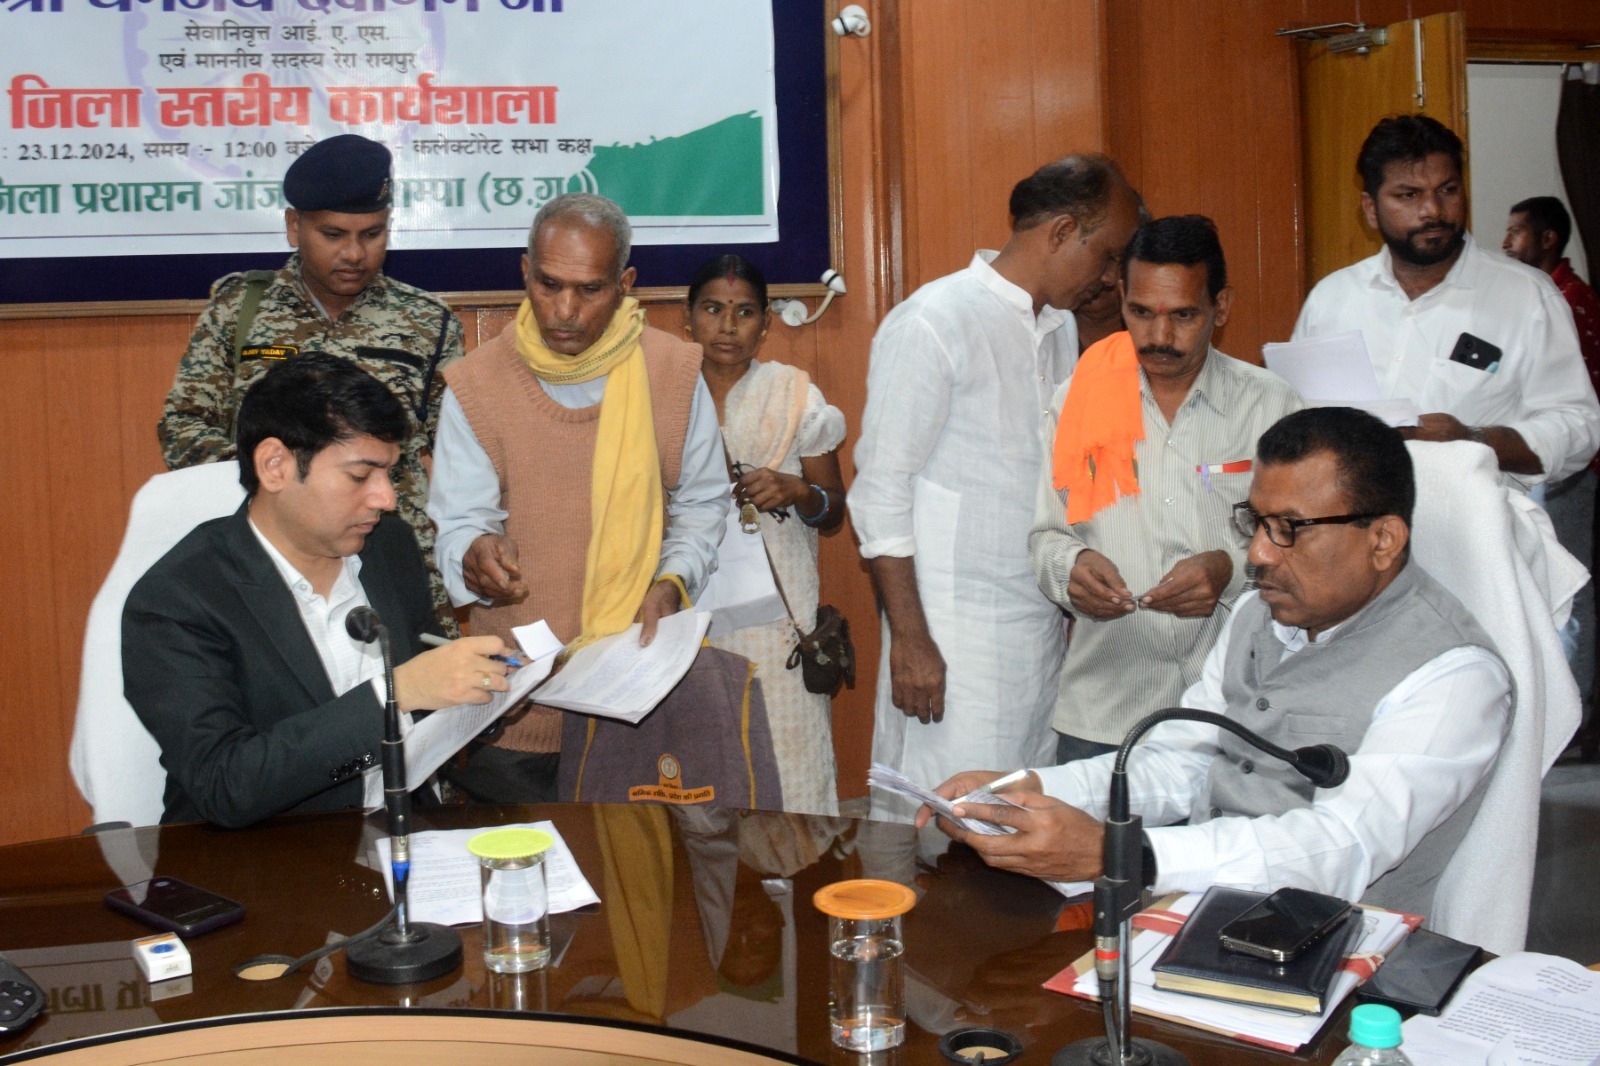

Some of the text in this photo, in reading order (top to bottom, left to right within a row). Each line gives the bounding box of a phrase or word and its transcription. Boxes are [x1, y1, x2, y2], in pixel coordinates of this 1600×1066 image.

[185, 19, 271, 47] सेवानिवृत्त
[159, 47, 416, 73] एवं माननीय सदस्य रेरा रायपुर
[7, 72, 559, 129] जिला स्तरीय कार्यशाला
[18, 142, 135, 163] 23.12.2024,
[144, 142, 189, 158] समय
[224, 141, 277, 158] 12:00
[413, 133, 503, 156] कलेक्टोरेट
[512, 139, 548, 154] सभा
[558, 138, 592, 155] कक्ष
[73, 181, 203, 214] प्रशासन
